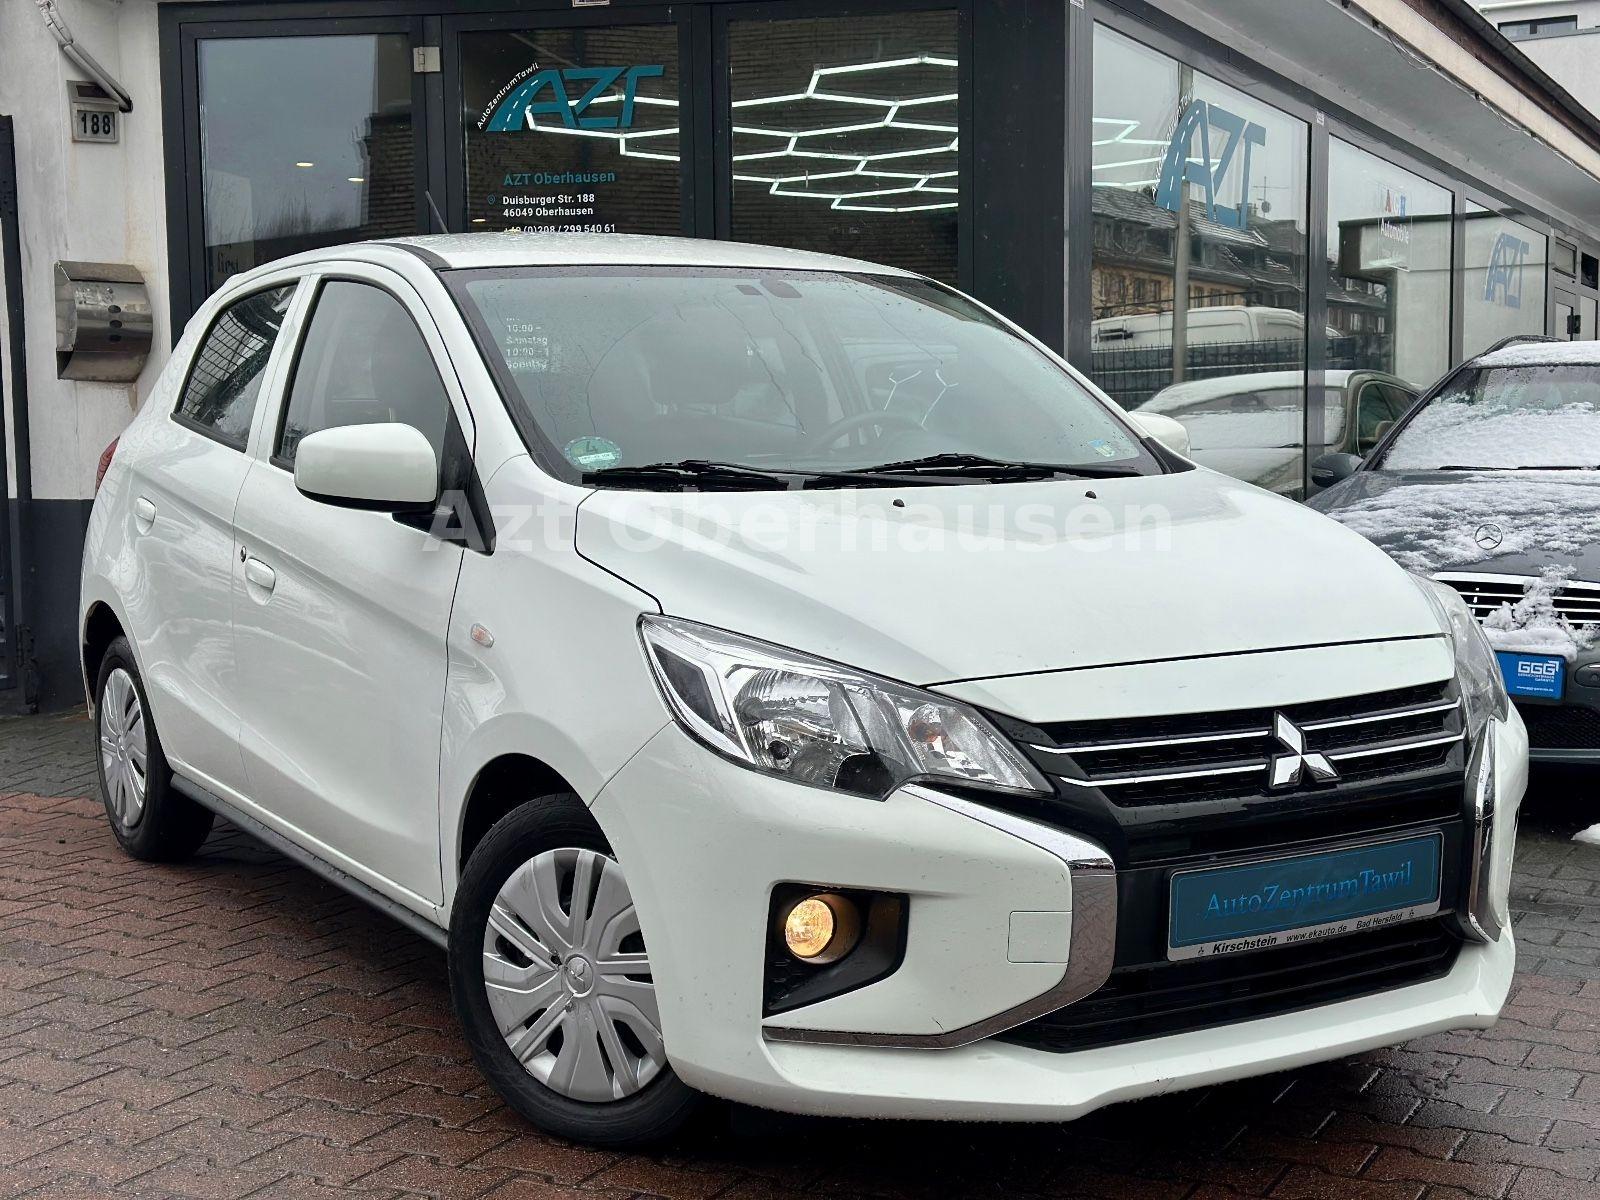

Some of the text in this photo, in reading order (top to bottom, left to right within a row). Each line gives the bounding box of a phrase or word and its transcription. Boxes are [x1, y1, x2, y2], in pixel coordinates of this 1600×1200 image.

[476, 62, 540, 130] AutoZentrumTawil
[485, 64, 664, 132] AZT
[81, 113, 111, 135] 188
[1155, 98, 1267, 231] AZT
[503, 171, 616, 186] AZT Oberhausen
[502, 193, 595, 207] Duisburger Str. 188
[503, 206, 594, 218] 46049 Oberhausen
[563, 225, 582, 233] 299
[584, 224, 602, 233] 540
[604, 224, 616, 233] 61
[1517, 661, 1556, 676] GGG
[1205, 860, 1412, 917] AutoZentrumTawil
[1212, 913, 1403, 954] Kirschstein www.ekauto.de Bad Hersfeld
